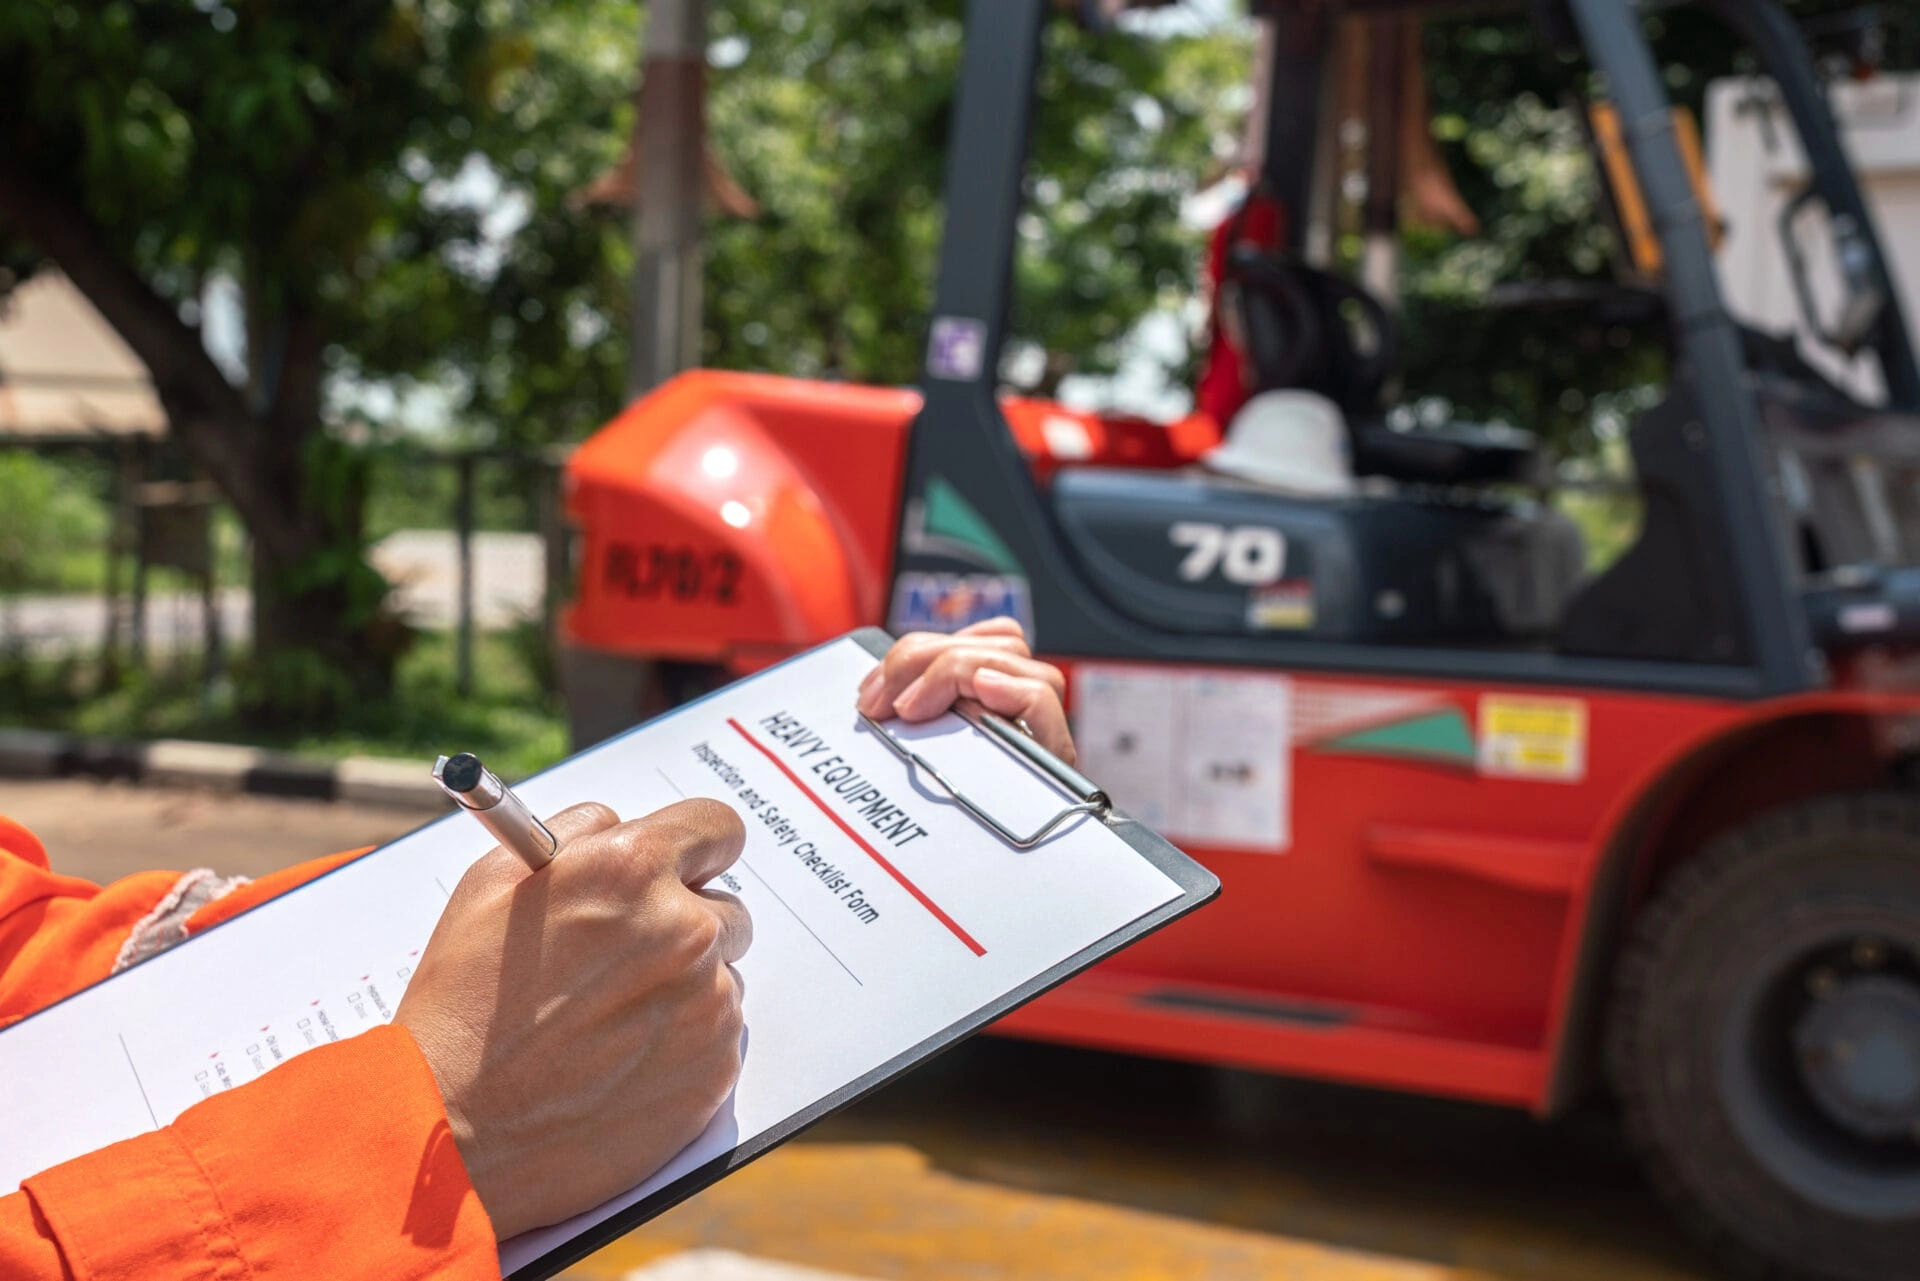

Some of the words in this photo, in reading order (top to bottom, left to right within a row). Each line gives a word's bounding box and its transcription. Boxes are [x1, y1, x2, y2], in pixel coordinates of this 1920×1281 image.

[1168, 522, 1286, 583] 70
[691, 741, 744, 789] Inspection
[738, 783, 766, 810] and
[758, 799, 802, 847] Safety
[793, 842, 852, 897] Checklist
[841, 888, 881, 925] Form
[758, 711, 831, 758] HEAVY
[811, 755, 930, 848] EQUIPMENT
